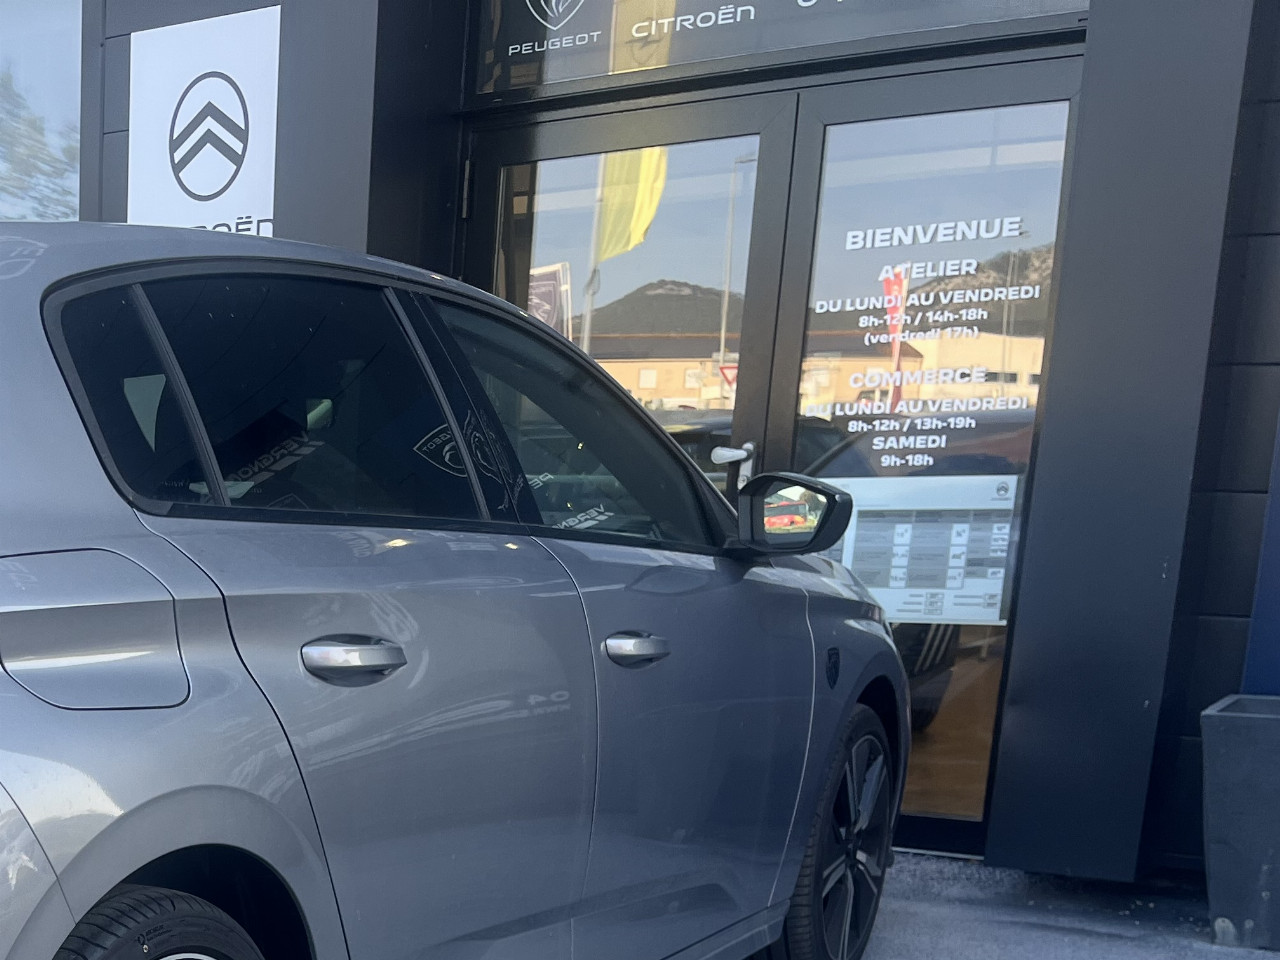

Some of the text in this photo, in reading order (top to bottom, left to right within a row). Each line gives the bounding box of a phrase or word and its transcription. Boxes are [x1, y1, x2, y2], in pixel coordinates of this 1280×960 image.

[631, 5, 756, 38] CITROËN
[508, 31, 602, 56] PEUGEOT
[845, 217, 1021, 250] BIENVENUE
[878, 259, 978, 282] ATELIER
[815, 285, 1041, 314] DU LUNDI AU VENDREDI
[858, 312, 912, 328] 8h-12h
[926, 308, 989, 322] 14h-18h
[848, 367, 988, 389] COMMERCE
[805, 396, 1029, 418] DU LUNDI AU VENDREDI
[847, 418, 900, 433] 8h-12h
[914, 416, 977, 430] 13h-19h
[871, 435, 947, 451] SAMEDI
[880, 454, 935, 467] 9h-18h
